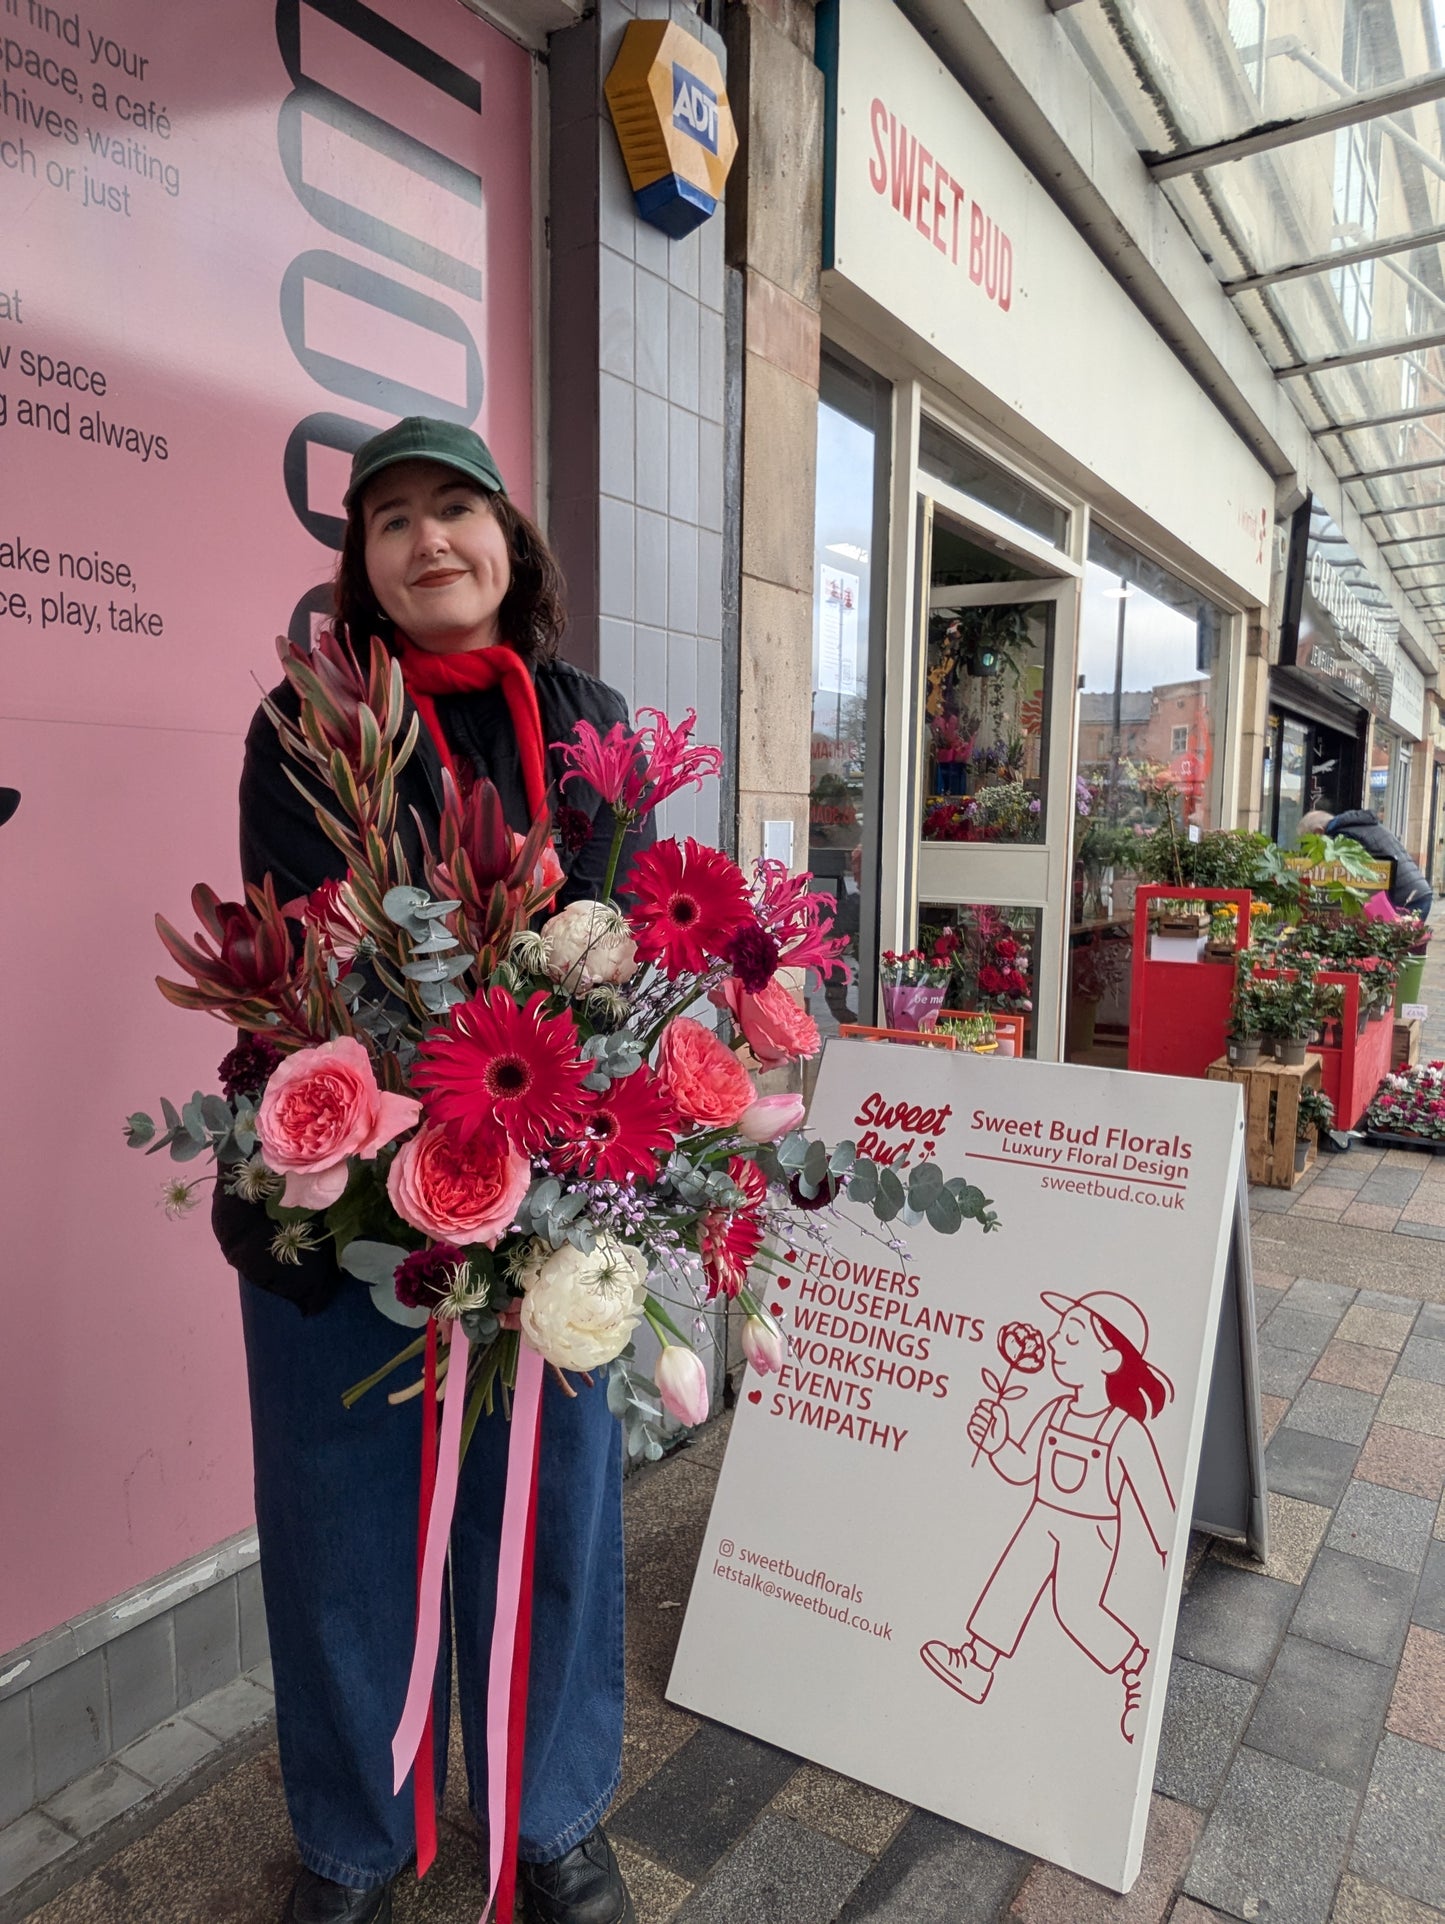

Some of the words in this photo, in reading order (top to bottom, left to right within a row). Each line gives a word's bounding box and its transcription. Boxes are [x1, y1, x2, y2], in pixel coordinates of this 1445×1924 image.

[88, 30, 149, 81] your
[0, 38, 83, 103] pace,
[92, 83, 108, 111] a
[116, 94, 171, 140] café
[672, 80, 718, 142] ADT
[0, 79, 79, 146] hives
[87, 128, 180, 197] waiting
[46, 161, 76, 192] or
[83, 167, 131, 217] just
[869, 98, 965, 266] SWEET
[969, 200, 1013, 312] BUD
[20, 350, 107, 397] space
[17, 399, 70, 436] and
[79, 411, 169, 463] always
[59, 552, 136, 592] noise,
[41, 592, 101, 635] play,
[109, 601, 163, 637] take
[854, 1092, 953, 1136] Sweet
[970, 1110, 1043, 1139] Sweet
[1049, 1120, 1099, 1147] Bud
[1105, 1128, 1193, 1160] Florals
[1001, 1137, 1063, 1163] Luxury
[1066, 1147, 1117, 1169] Floral
[1122, 1155, 1190, 1181] Design
[1040, 1175, 1186, 1211] sweetbud.co.uk
[806, 1253, 921, 1298] FLOWERS
[793, 1306, 931, 1361] WEDDINGS
[799, 1279, 985, 1342] HOUSEPLANTS
[777, 1364, 873, 1410] EVENTS
[788, 1334, 949, 1399] WORKSHOPS
[770, 1393, 909, 1452] SYMPATHY
[713, 1559, 893, 1641] letstalk@sweetbud.co.uk
[739, 1549, 864, 1604] sweetbudflorals
